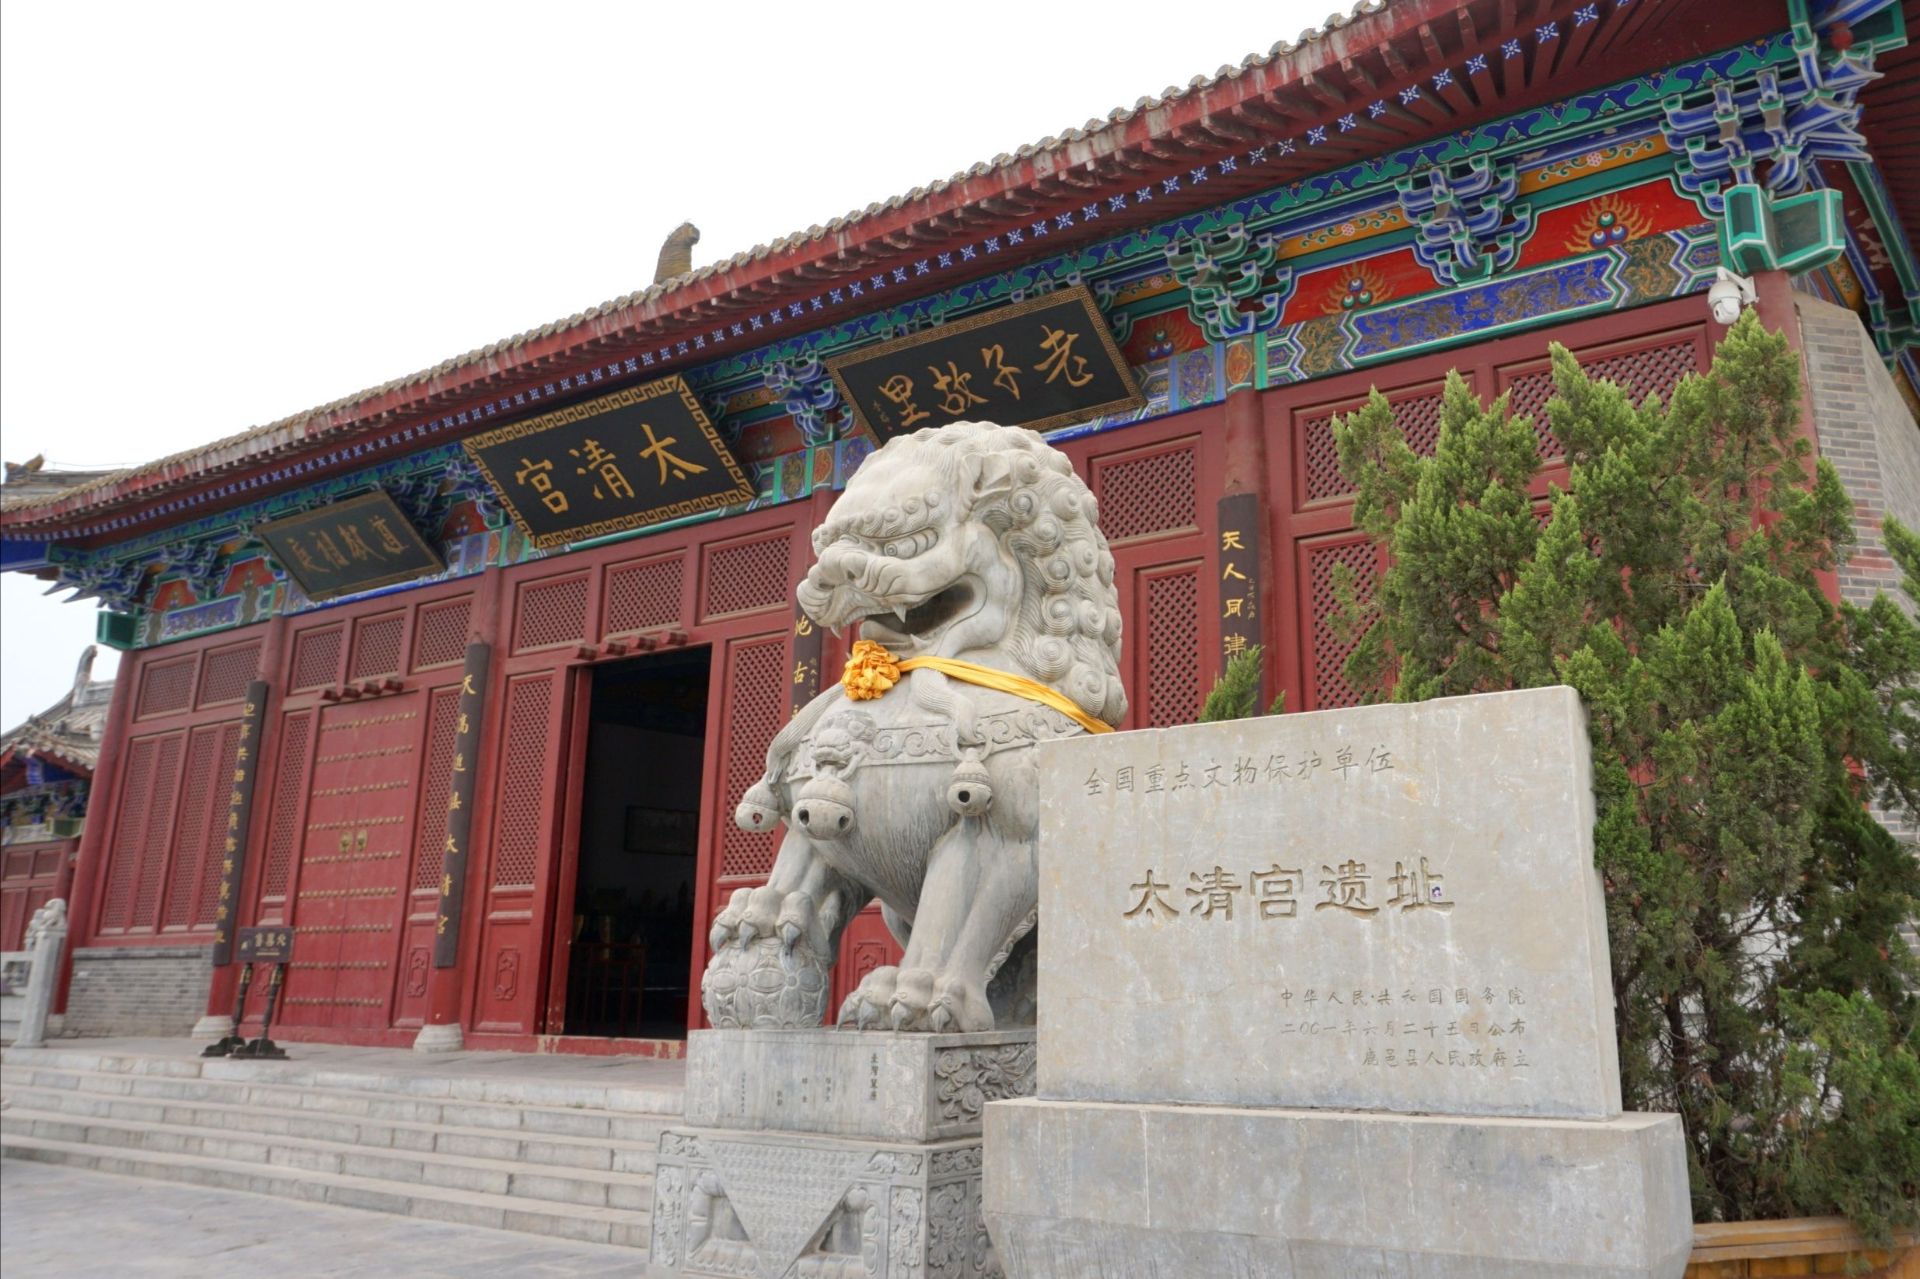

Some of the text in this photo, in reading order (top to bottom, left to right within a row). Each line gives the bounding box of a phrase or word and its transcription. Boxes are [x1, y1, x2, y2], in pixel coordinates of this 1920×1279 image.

[878, 324, 1094, 427] 老子故里
[1222, 530, 1247, 656] 天人同津
[1083, 744, 1395, 797] 全国重点文物保护单位
[1123, 856, 1455, 922] 太清宫遗址
[1280, 986, 1527, 1008] 中华人民共和国国务院
[1362, 1047, 1531, 1068] 鹿邑县人民政府立
